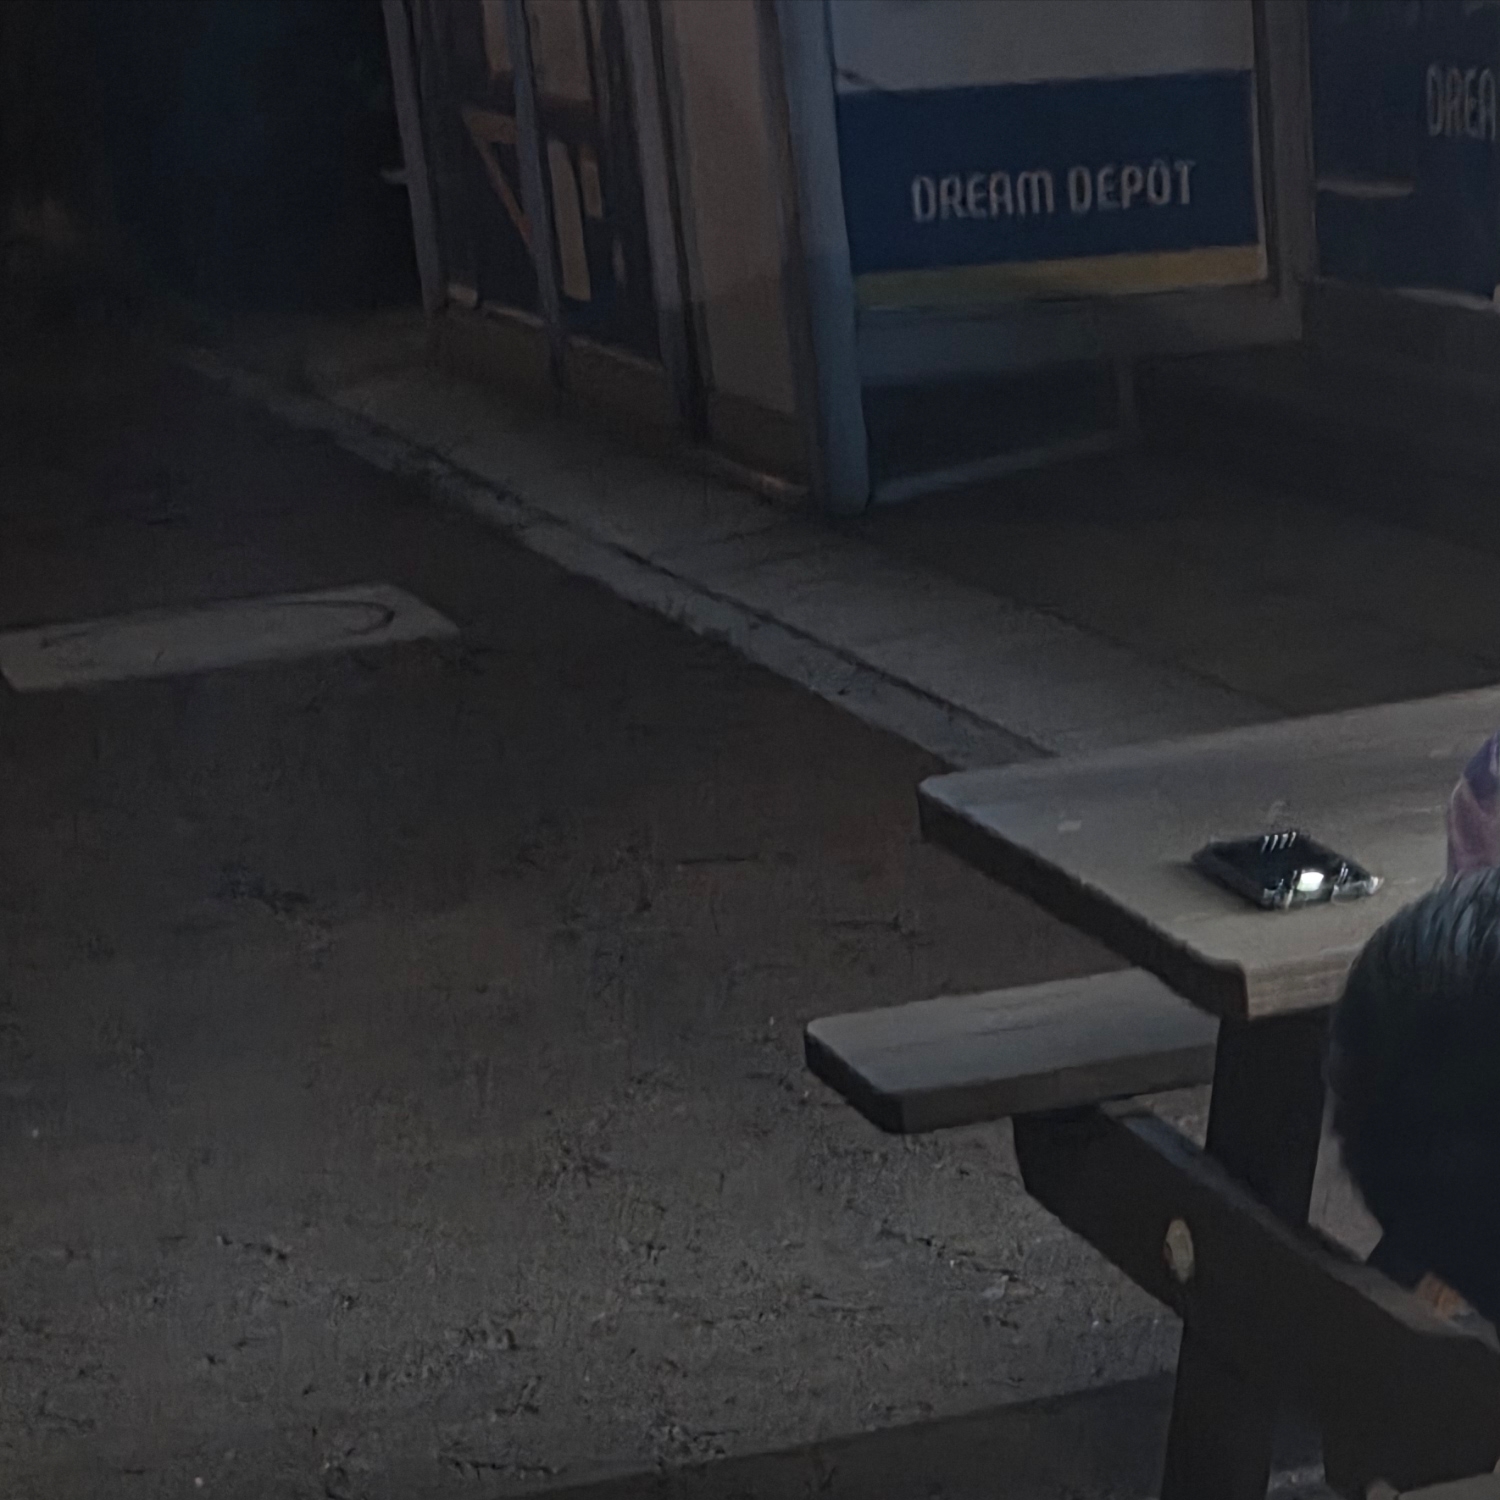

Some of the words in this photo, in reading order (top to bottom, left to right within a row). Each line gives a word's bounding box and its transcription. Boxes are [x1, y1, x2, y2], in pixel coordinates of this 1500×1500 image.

[1426, 63, 1497, 141] DREA
[911, 169, 1056, 222] DREAM
[1067, 158, 1196, 213] DEPOT
